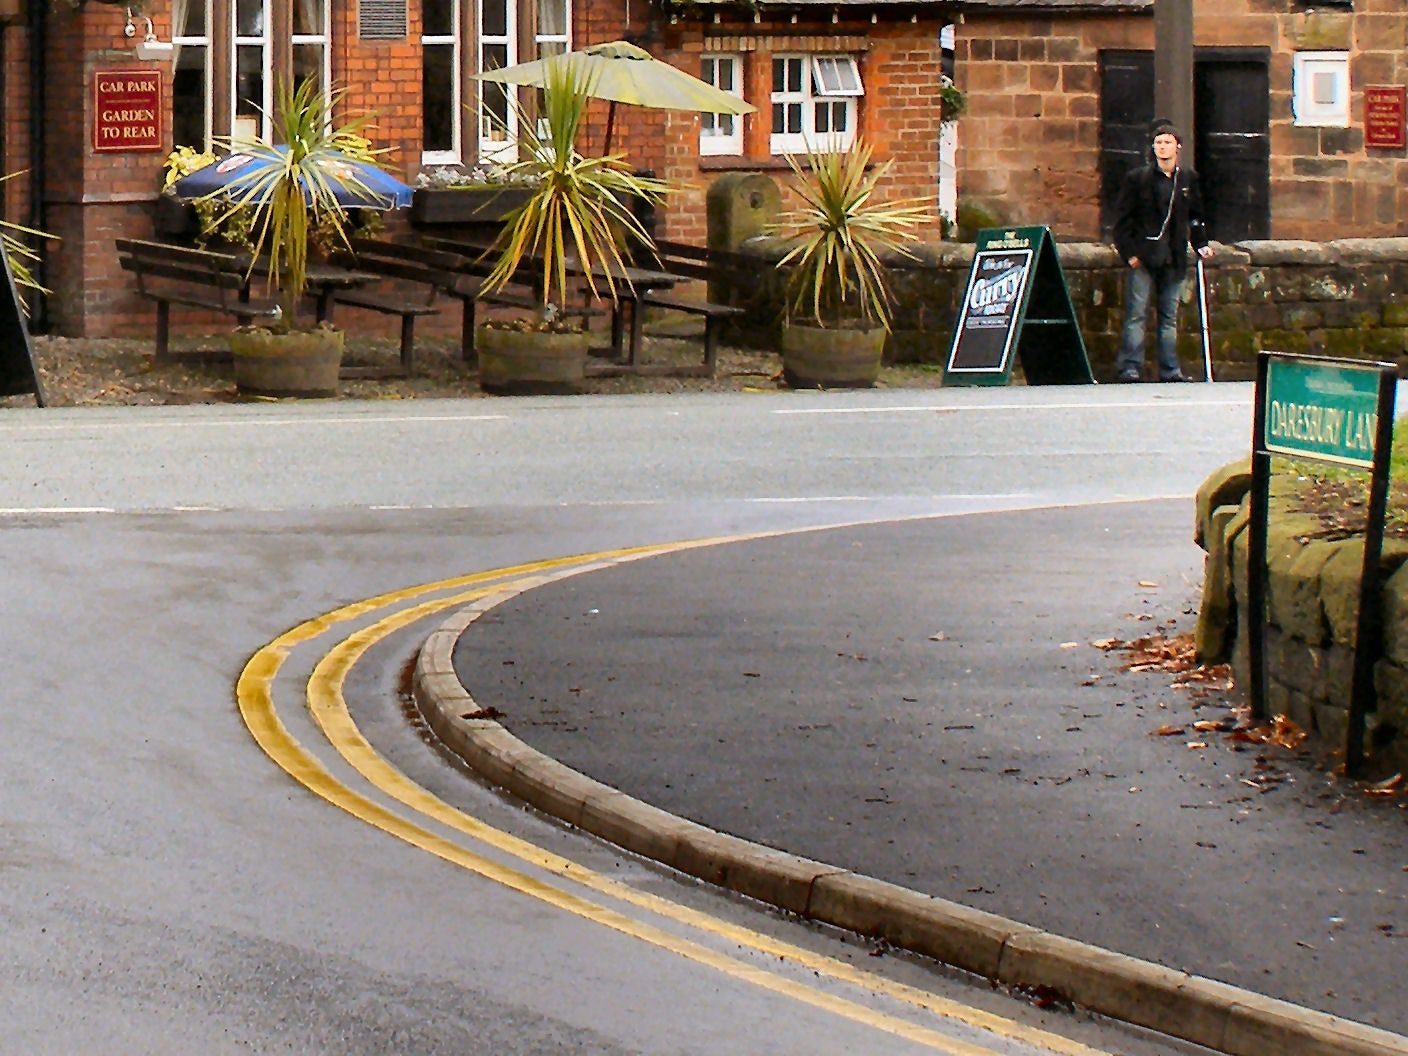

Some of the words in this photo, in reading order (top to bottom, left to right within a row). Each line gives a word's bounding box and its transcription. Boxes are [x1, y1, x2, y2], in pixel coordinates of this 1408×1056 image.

[99, 81, 124, 93] CAR
[127, 80, 156, 92] PARK
[102, 109, 155, 122] GARDEN
[101, 127, 120, 139] TO
[123, 126, 156, 138] REAR
[1345, 410, 1379, 452] LAN
